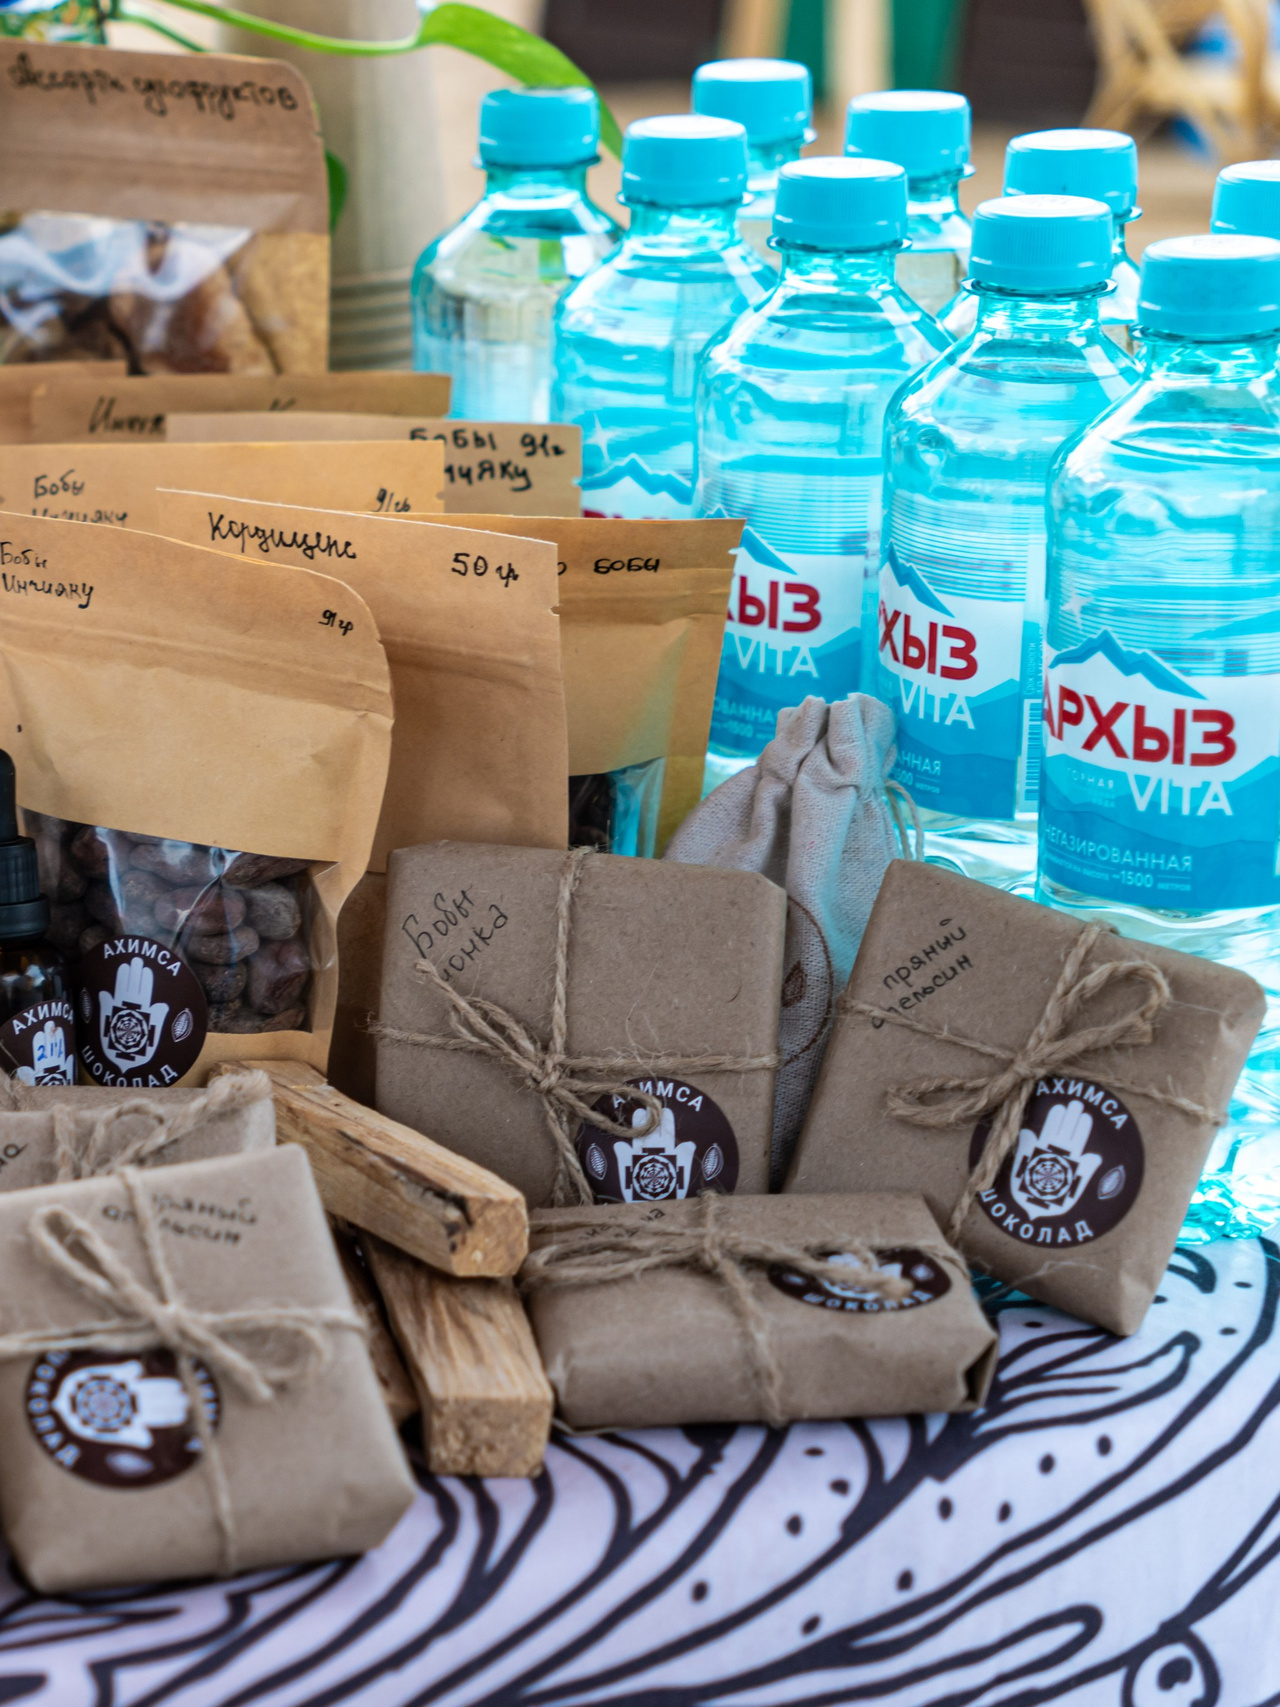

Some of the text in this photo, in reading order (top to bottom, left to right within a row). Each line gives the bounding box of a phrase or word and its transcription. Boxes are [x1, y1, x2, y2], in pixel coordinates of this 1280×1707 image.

[450, 551, 488, 577] 50
[734, 635, 819, 678] VITA
[878, 600, 979, 681] ХЫЗ
[899, 676, 976, 730] VITA
[1125, 771, 1234, 817] VITA
[103, 938, 183, 977] АХИМСА
[81, 1045, 179, 1088] ШОКОЛАД
[612, 1080, 704, 1113] АИМСА
[1036, 1077, 1129, 1130] АХИМСА
